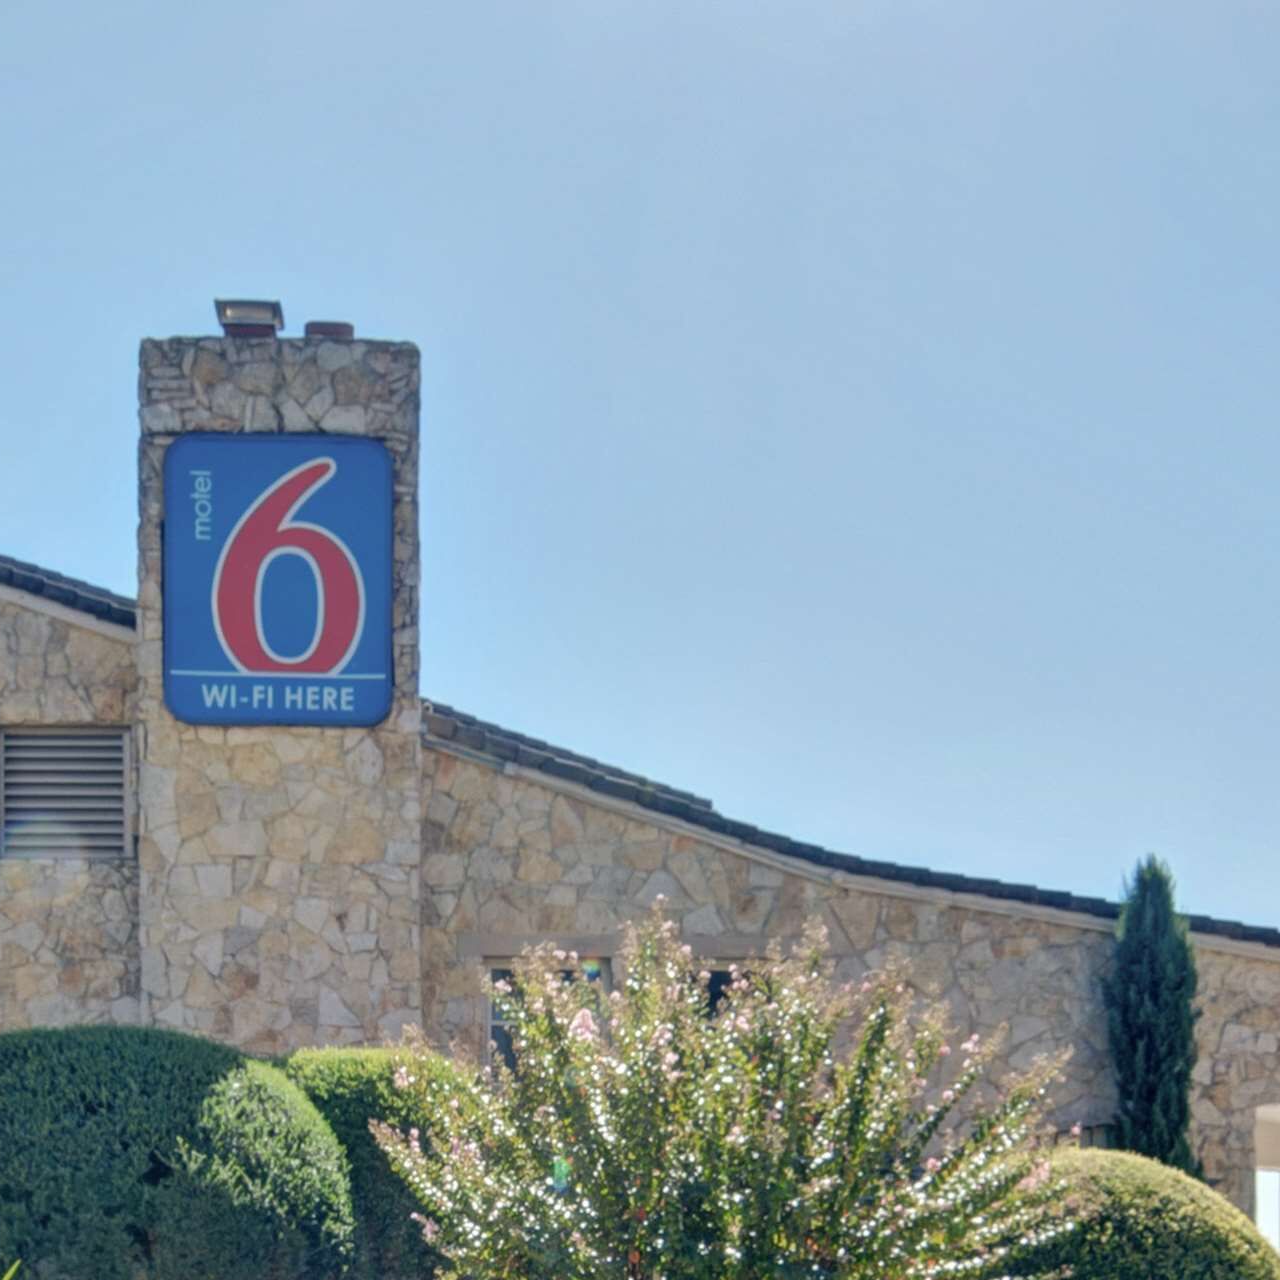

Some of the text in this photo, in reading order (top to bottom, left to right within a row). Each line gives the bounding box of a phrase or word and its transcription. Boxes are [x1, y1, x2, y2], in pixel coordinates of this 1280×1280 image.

[189, 470, 212, 541] motel
[211, 456, 366, 677] 6
[201, 683, 355, 711] WI-FI HERE
